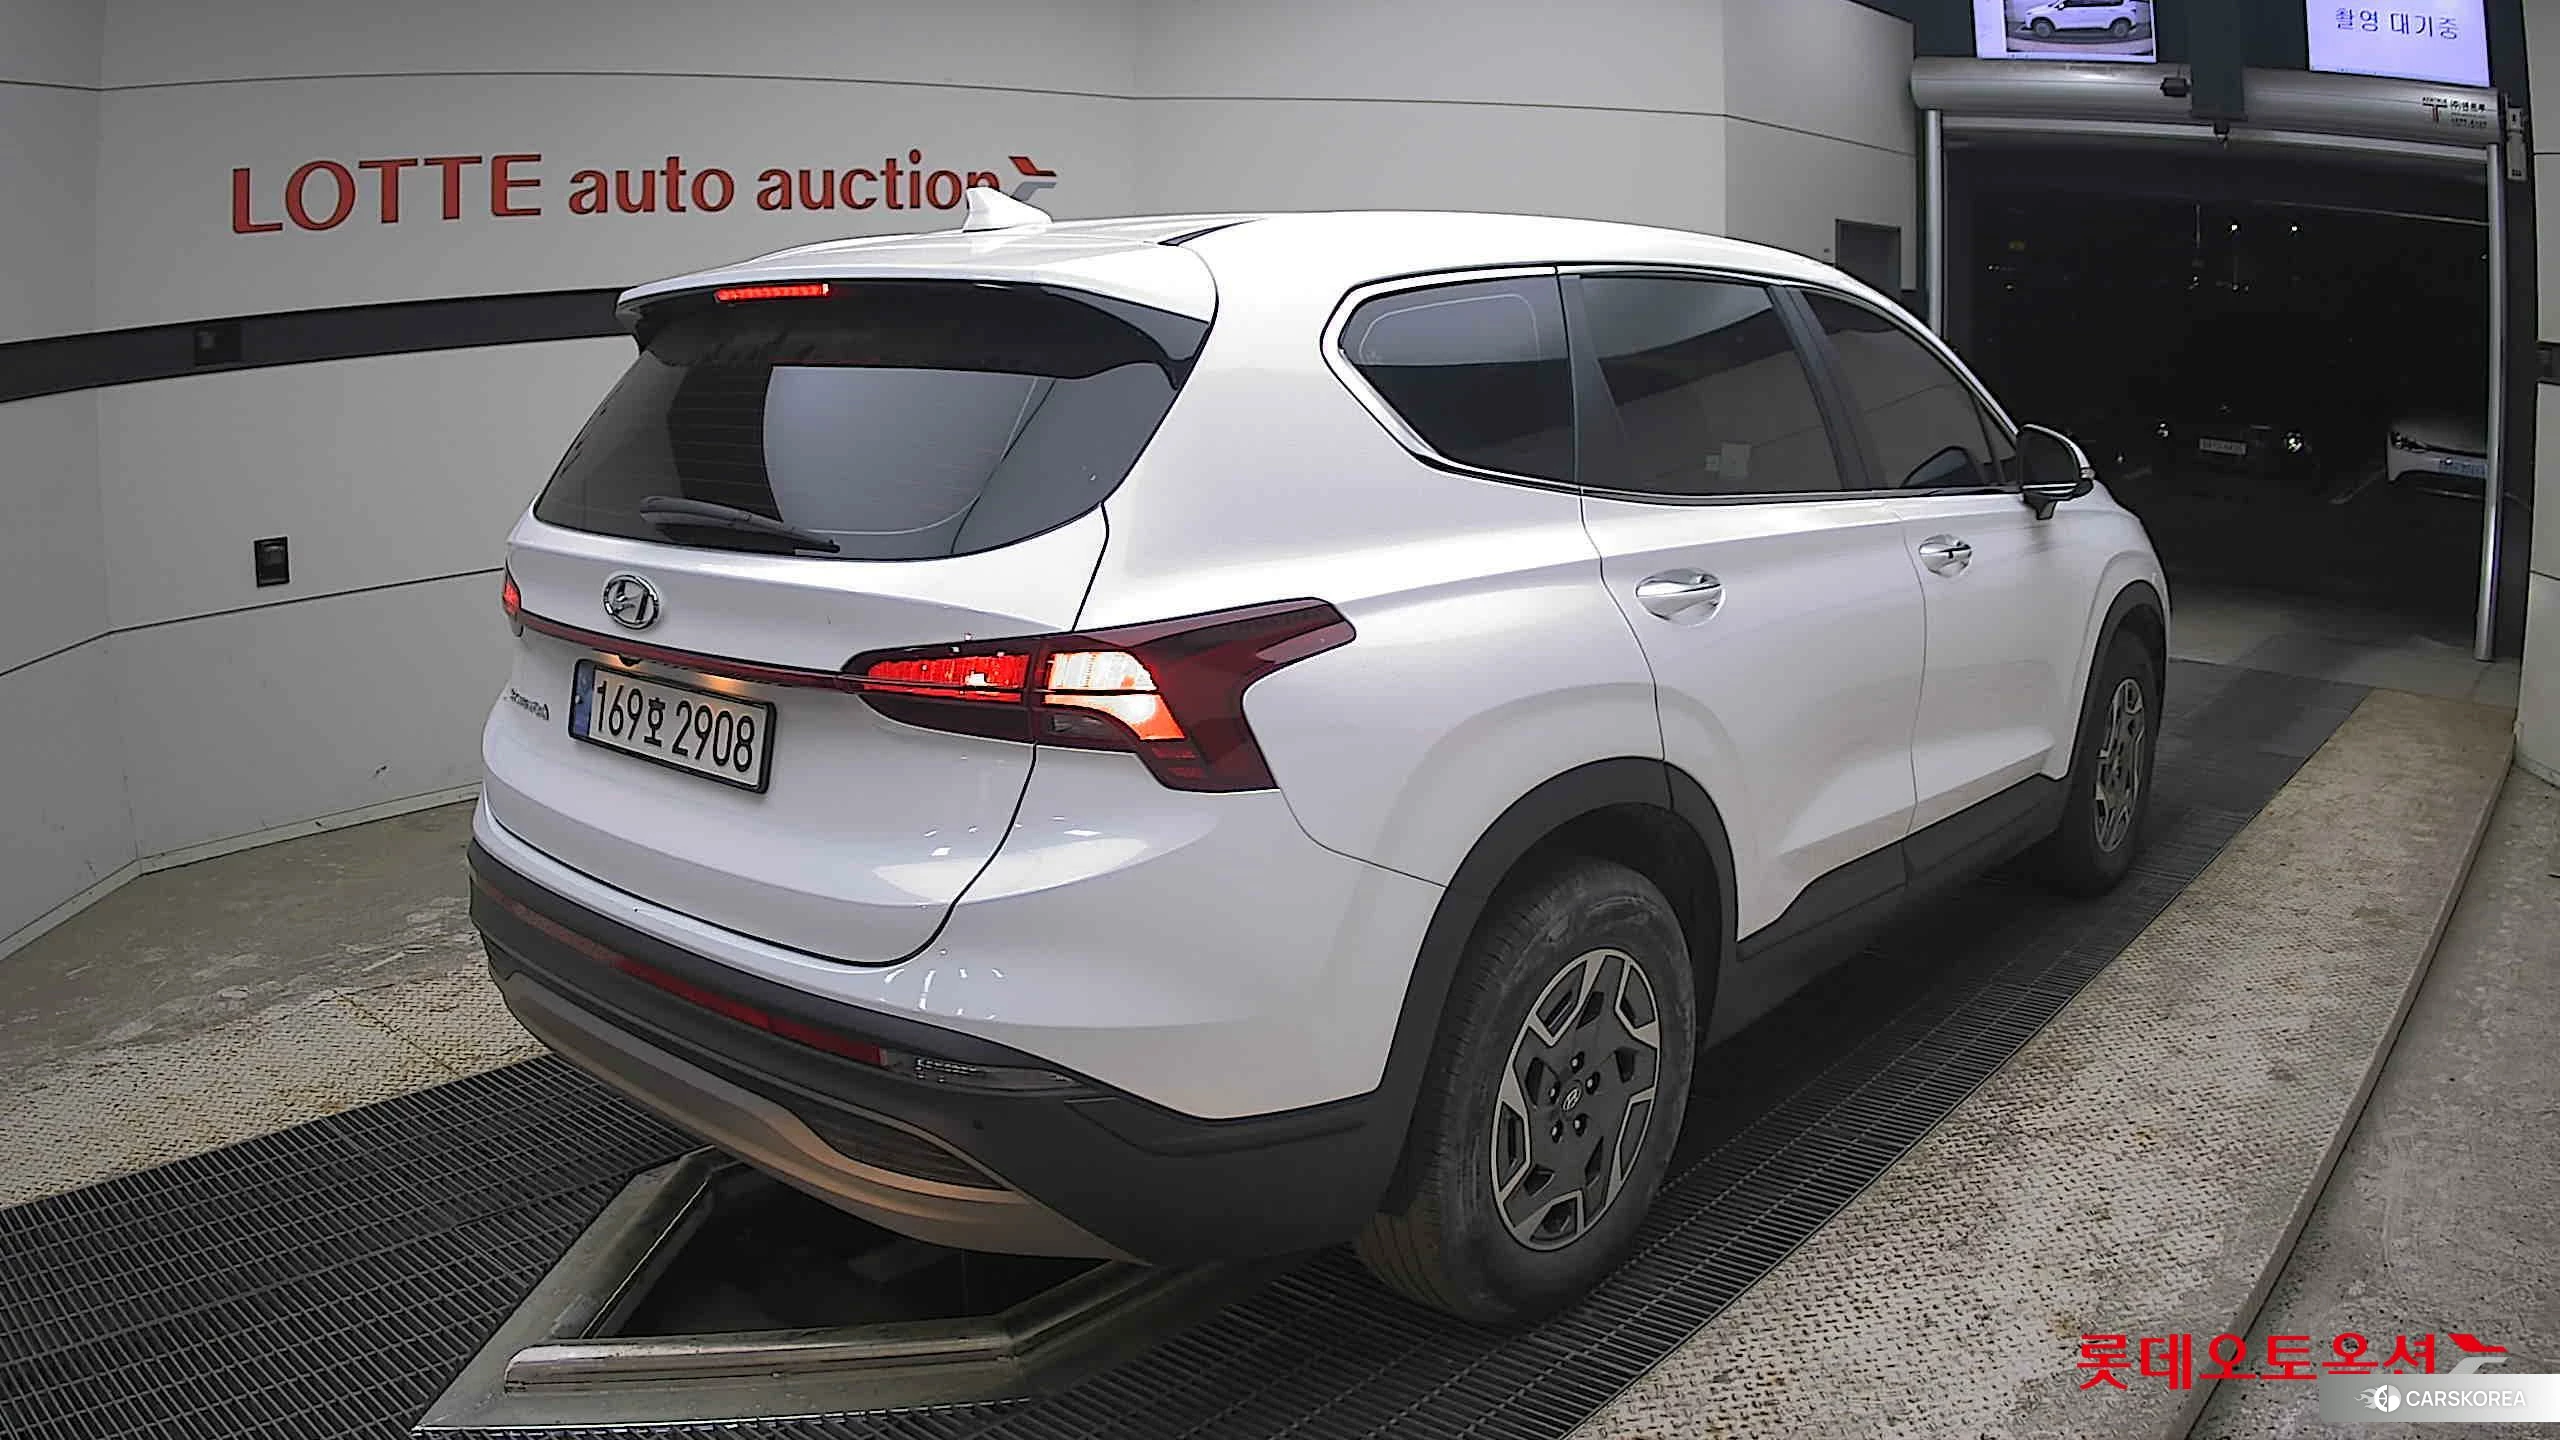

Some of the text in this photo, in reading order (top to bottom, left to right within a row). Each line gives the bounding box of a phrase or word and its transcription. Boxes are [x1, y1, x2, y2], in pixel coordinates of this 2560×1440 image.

[2336, 8, 2378, 32] 촬영
[231, 154, 543, 234] LOTTE
[568, 155, 735, 214] auto
[596, 680, 665, 748] 169호
[672, 701, 755, 773] 2908
